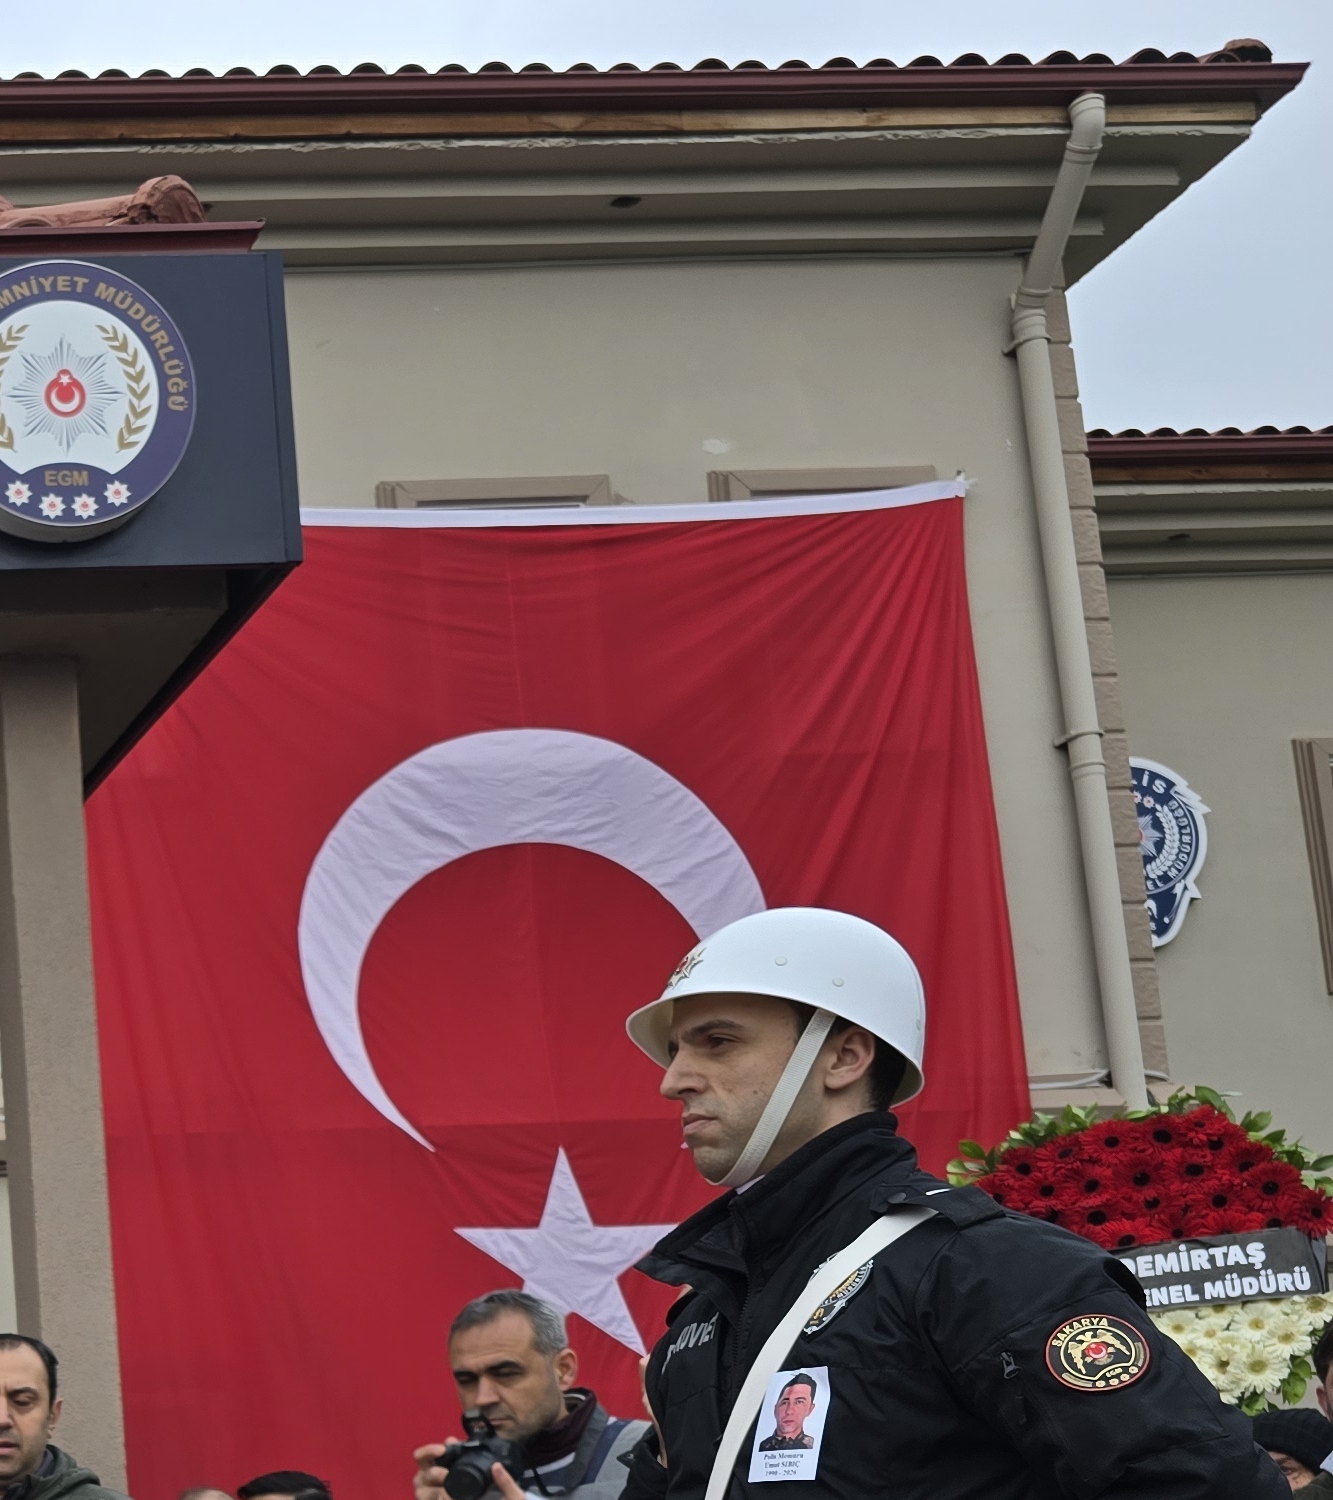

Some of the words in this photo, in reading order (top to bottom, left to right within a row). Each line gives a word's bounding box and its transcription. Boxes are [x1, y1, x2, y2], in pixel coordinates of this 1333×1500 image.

[94, 282, 190, 411] MÜDÜRLÜĞÜ
[44, 470, 89, 487] EGM
[1144, 1284, 1200, 1307] NEL
[1204, 1265, 1312, 1299] MÜDÜRÜ
[1051, 1317, 1109, 1347] SAKARYA
